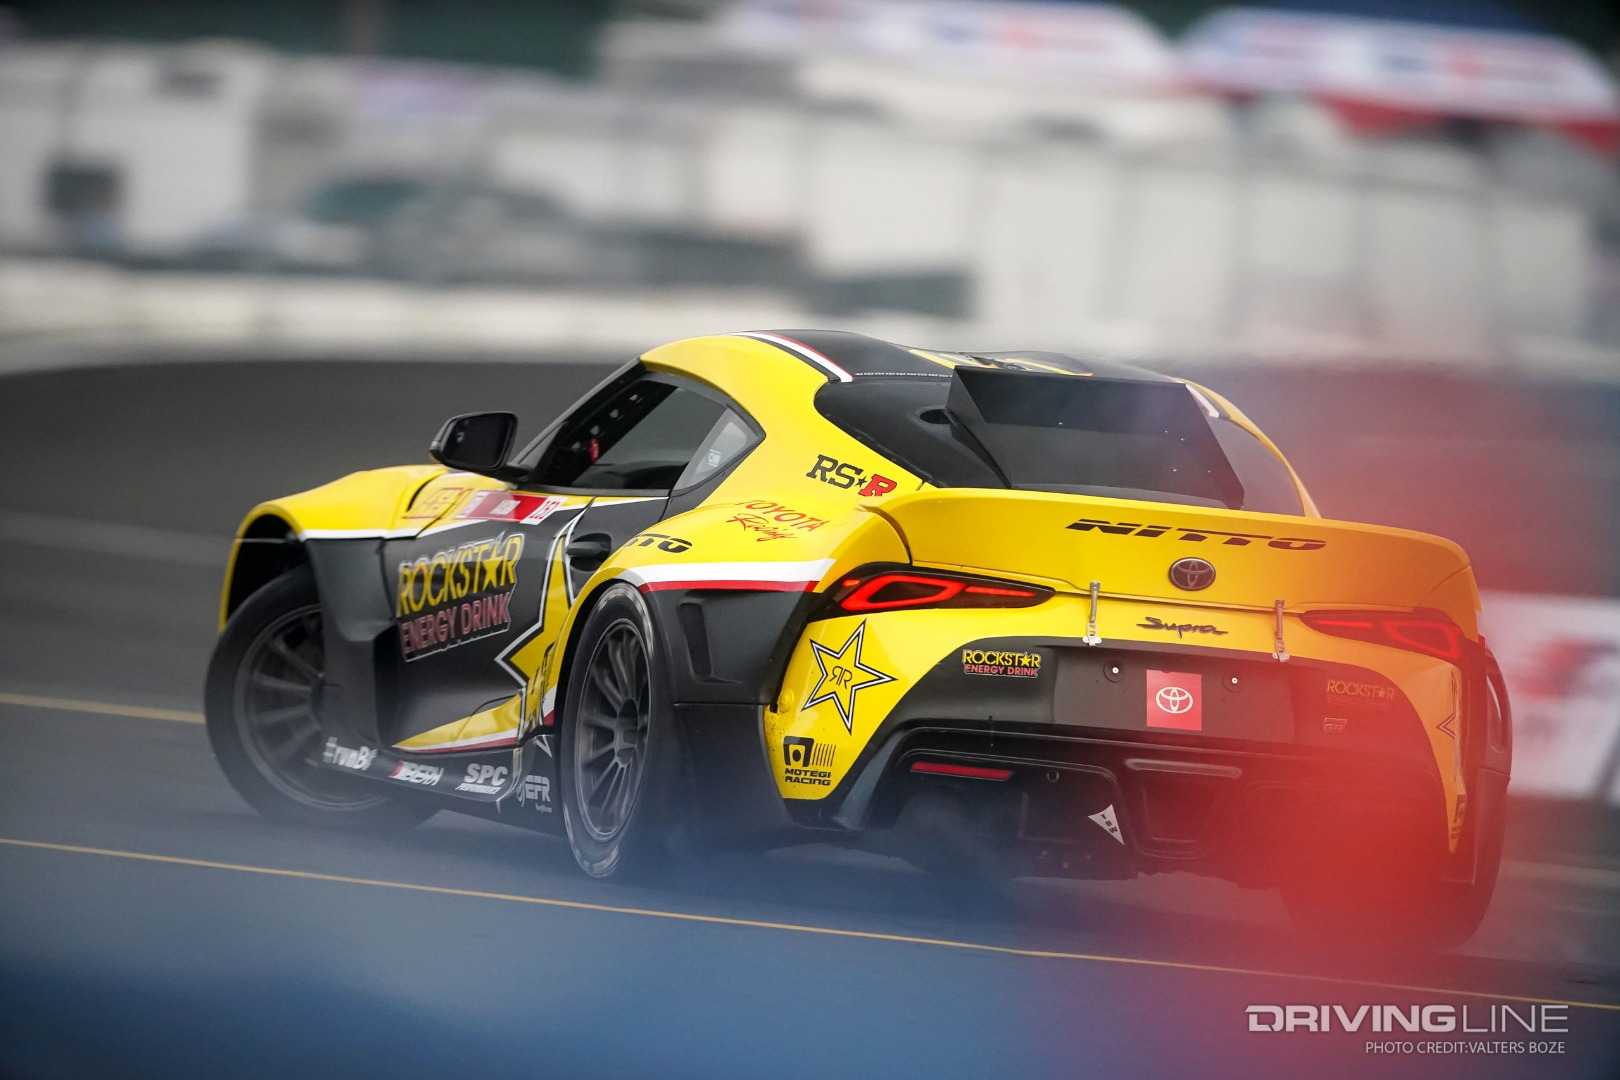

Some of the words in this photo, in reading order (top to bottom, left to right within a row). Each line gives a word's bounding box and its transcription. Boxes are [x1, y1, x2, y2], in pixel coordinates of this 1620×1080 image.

[734, 500, 830, 532] TOYOTA
[625, 533, 693, 553] TTO
[1065, 518, 1327, 550] NITTO
[401, 607, 457, 653] ENERGY
[461, 592, 511, 635] DRINK
[1136, 616, 1228, 639] Supra
[965, 664, 1006, 674] ENERGY
[1007, 666, 1037, 676] DRINK
[464, 763, 508, 786] SPC
[785, 768, 831, 778] MOTEGI
[785, 776, 831, 786] RACING
[1100, 813, 1118, 834] TOW
